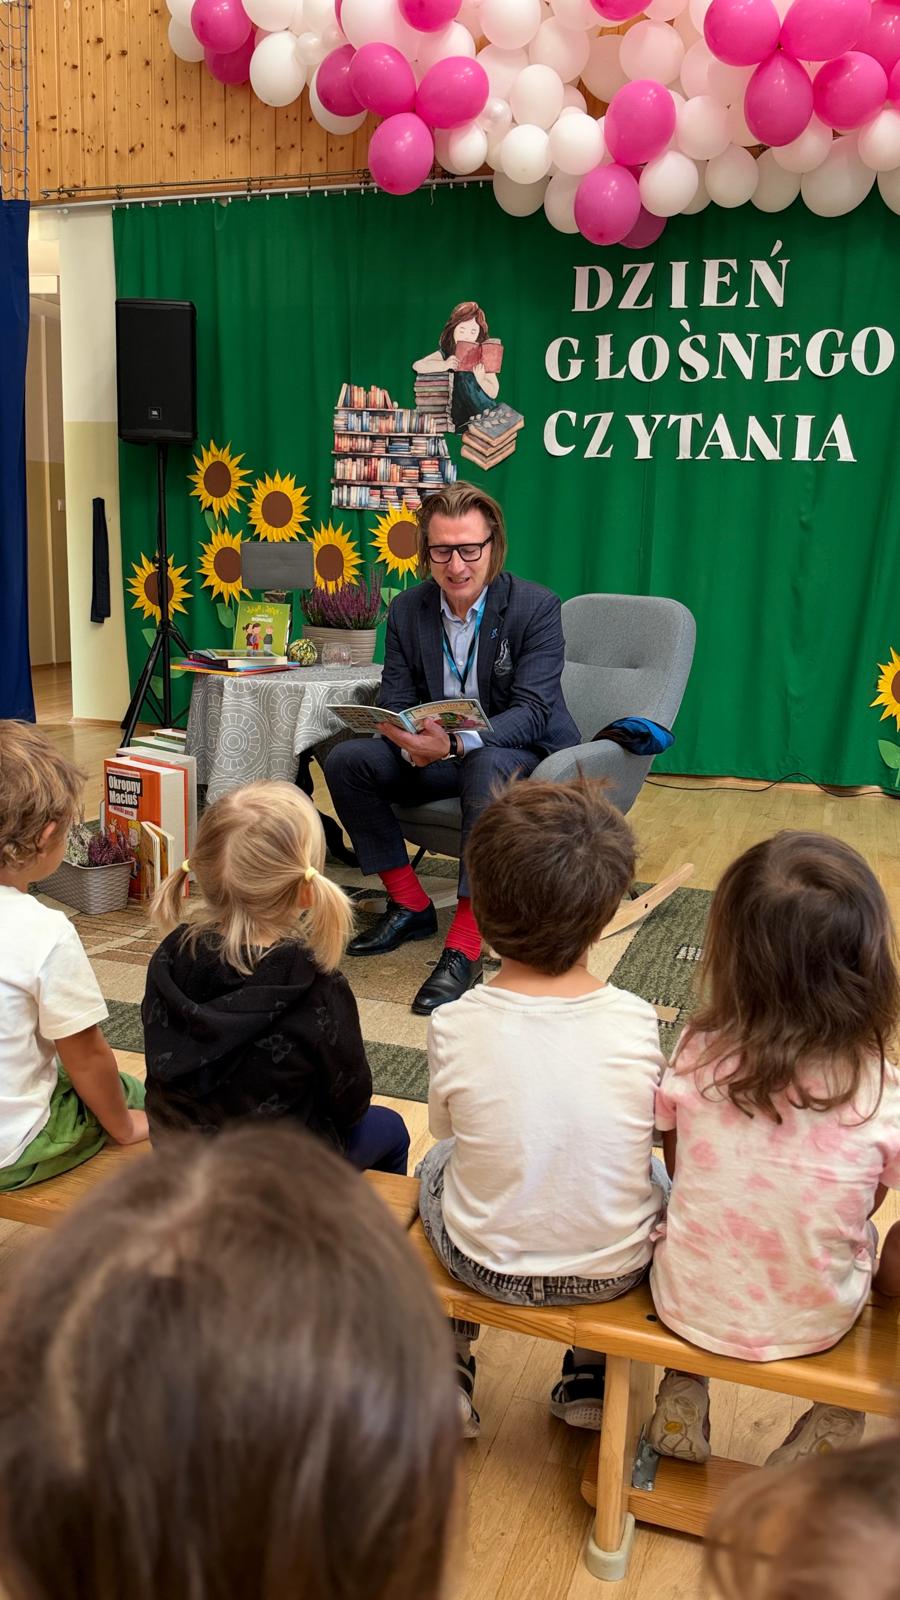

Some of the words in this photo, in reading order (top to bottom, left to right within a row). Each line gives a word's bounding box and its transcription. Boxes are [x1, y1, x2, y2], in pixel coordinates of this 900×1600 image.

[572, 240, 791, 312] DZIEŃ
[544, 410, 857, 462] CZYTANIA
[108, 776, 141, 794] Okropny
[109, 791, 138, 805] Maciuś
